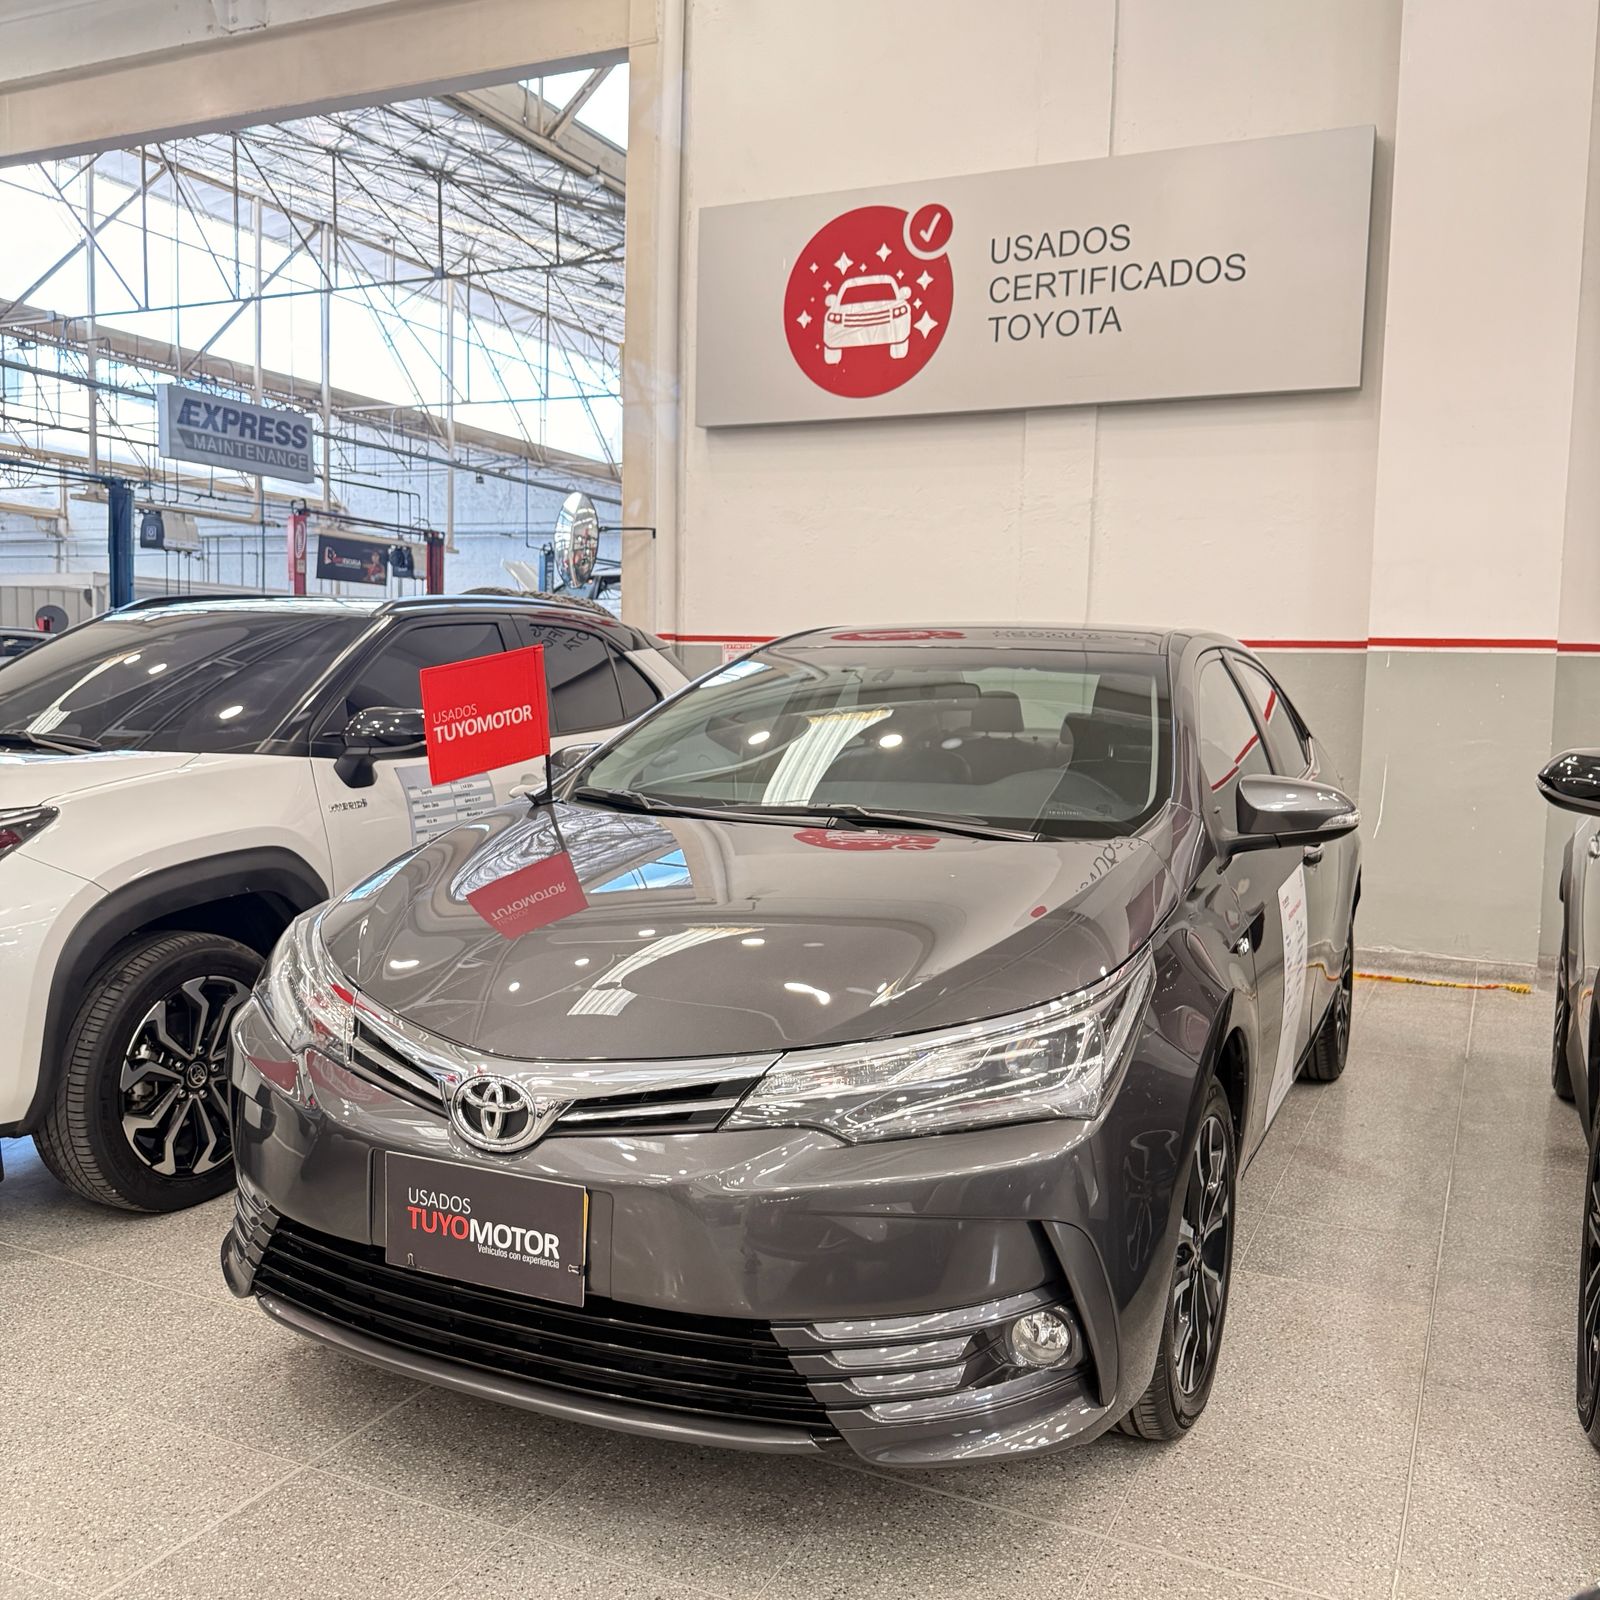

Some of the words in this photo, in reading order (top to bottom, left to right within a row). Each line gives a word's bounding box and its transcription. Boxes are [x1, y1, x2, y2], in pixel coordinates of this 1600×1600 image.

[991, 224, 1131, 264] USADOS
[989, 253, 1246, 303] CERTIFICADOS
[988, 306, 1122, 342] TOYOTA
[177, 398, 308, 449] EXPRESS
[193, 433, 308, 470] MAINTENANCE
[433, 703, 477, 724] USADOS
[433, 704, 533, 743] TUYOMOTOR
[408, 1187, 471, 1214] USADOS
[407, 1206, 560, 1260] TUYOMOTOR
[508, 1252, 521, 1261] con
[522, 1254, 560, 1269] experiencia
